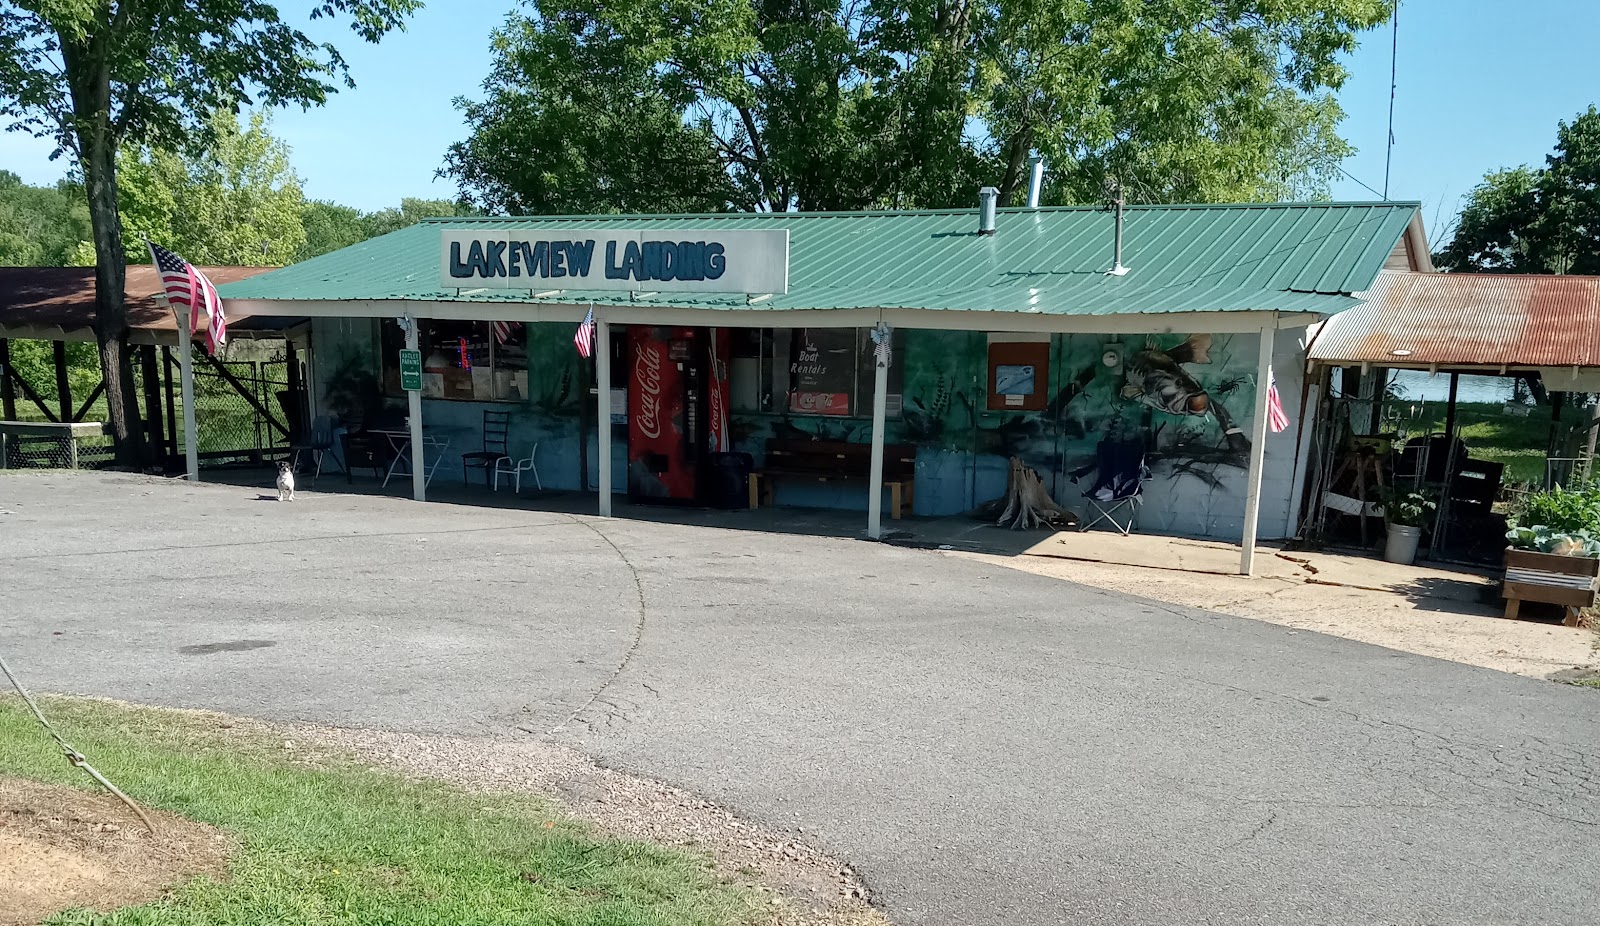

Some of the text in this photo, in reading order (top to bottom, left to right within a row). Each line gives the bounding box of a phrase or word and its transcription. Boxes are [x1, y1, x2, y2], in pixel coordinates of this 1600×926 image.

[449, 239, 727, 281] LAKEVIEW LANDING
[460, 338, 469, 369] OPEN
[790, 362, 827, 375] Rentals
[798, 350, 819, 362] Boat
[635, 342, 662, 440] Coca-Cola
